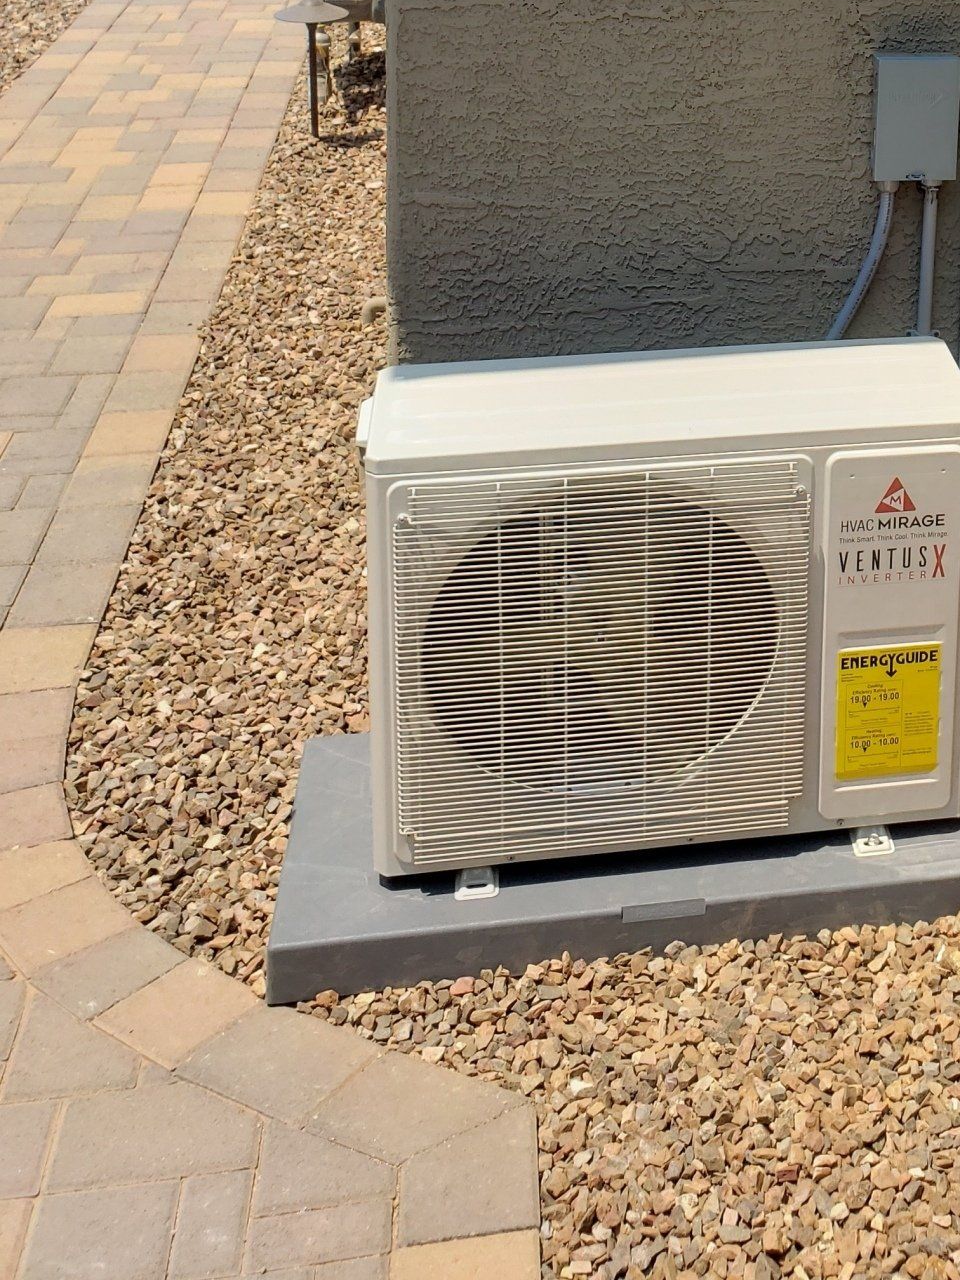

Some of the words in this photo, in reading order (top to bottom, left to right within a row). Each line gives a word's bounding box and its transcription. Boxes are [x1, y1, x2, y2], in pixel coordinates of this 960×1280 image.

[840, 518, 874, 533] HVAC
[878, 513, 946, 530] MIRAGE
[877, 533, 893, 541] Think
[910, 531, 926, 539] Think
[838, 570, 927, 585] INVERTER
[840, 649, 939, 672] ENERGYGUIDE
[850, 694, 871, 704] 19.00
[879, 692, 900, 702] 19.00
[850, 739, 871, 749] 10.00
[879, 737, 899, 747] 10.00
